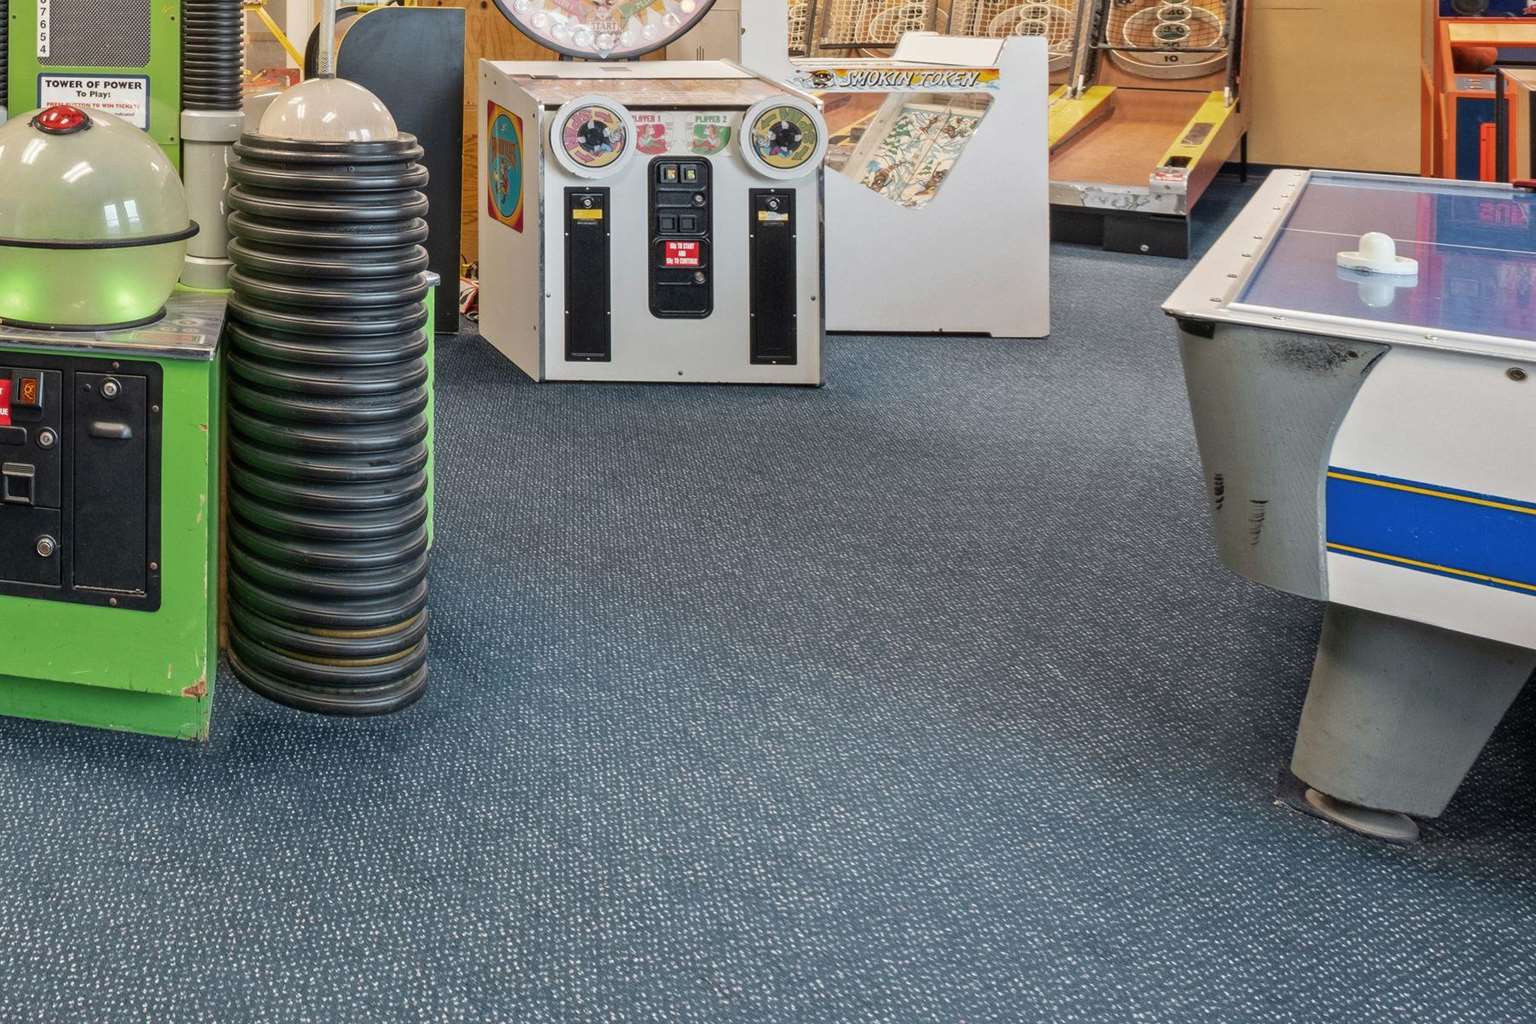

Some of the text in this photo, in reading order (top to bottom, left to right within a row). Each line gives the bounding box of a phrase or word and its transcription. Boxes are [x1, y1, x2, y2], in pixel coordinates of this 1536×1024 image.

[40, 7, 46, 17] 7
[40, 19, 46, 30] 6
[40, 32, 46, 43] 5
[40, 44, 46, 55] 4
[45, 79, 143, 90] TOWER OF POWER
[839, 70, 981, 88] SMOKIN TOKEN
[76, 90, 87, 98] To
